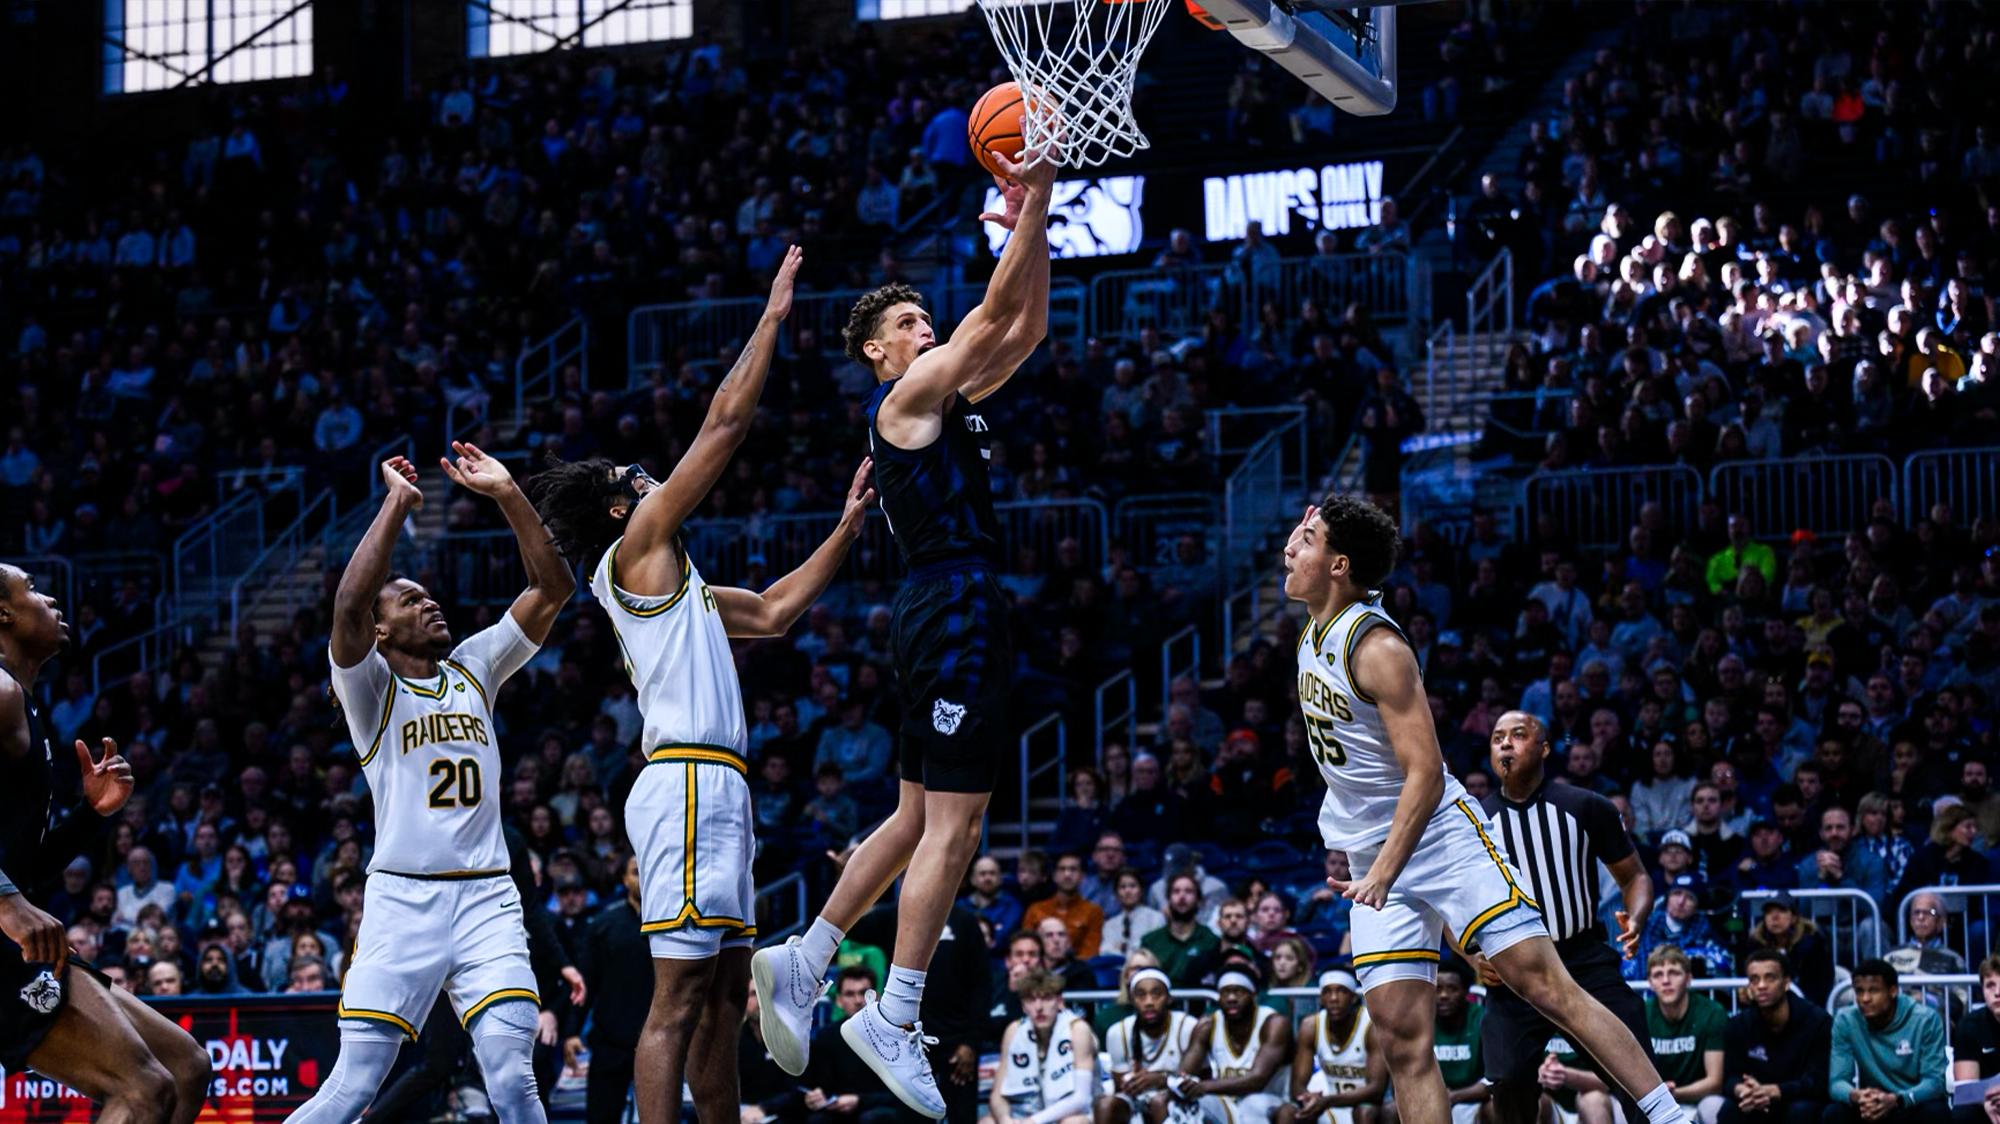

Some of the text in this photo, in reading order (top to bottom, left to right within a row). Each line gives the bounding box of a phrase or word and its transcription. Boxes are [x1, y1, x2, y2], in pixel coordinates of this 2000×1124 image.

[1321, 160, 1383, 230] ONLY
[402, 712, 489, 756] RAIDERS
[1305, 712, 1348, 766] 55
[427, 757, 482, 809] 20
[206, 1038, 289, 1071] DALY
[15, 1080, 87, 1099] INDIA
